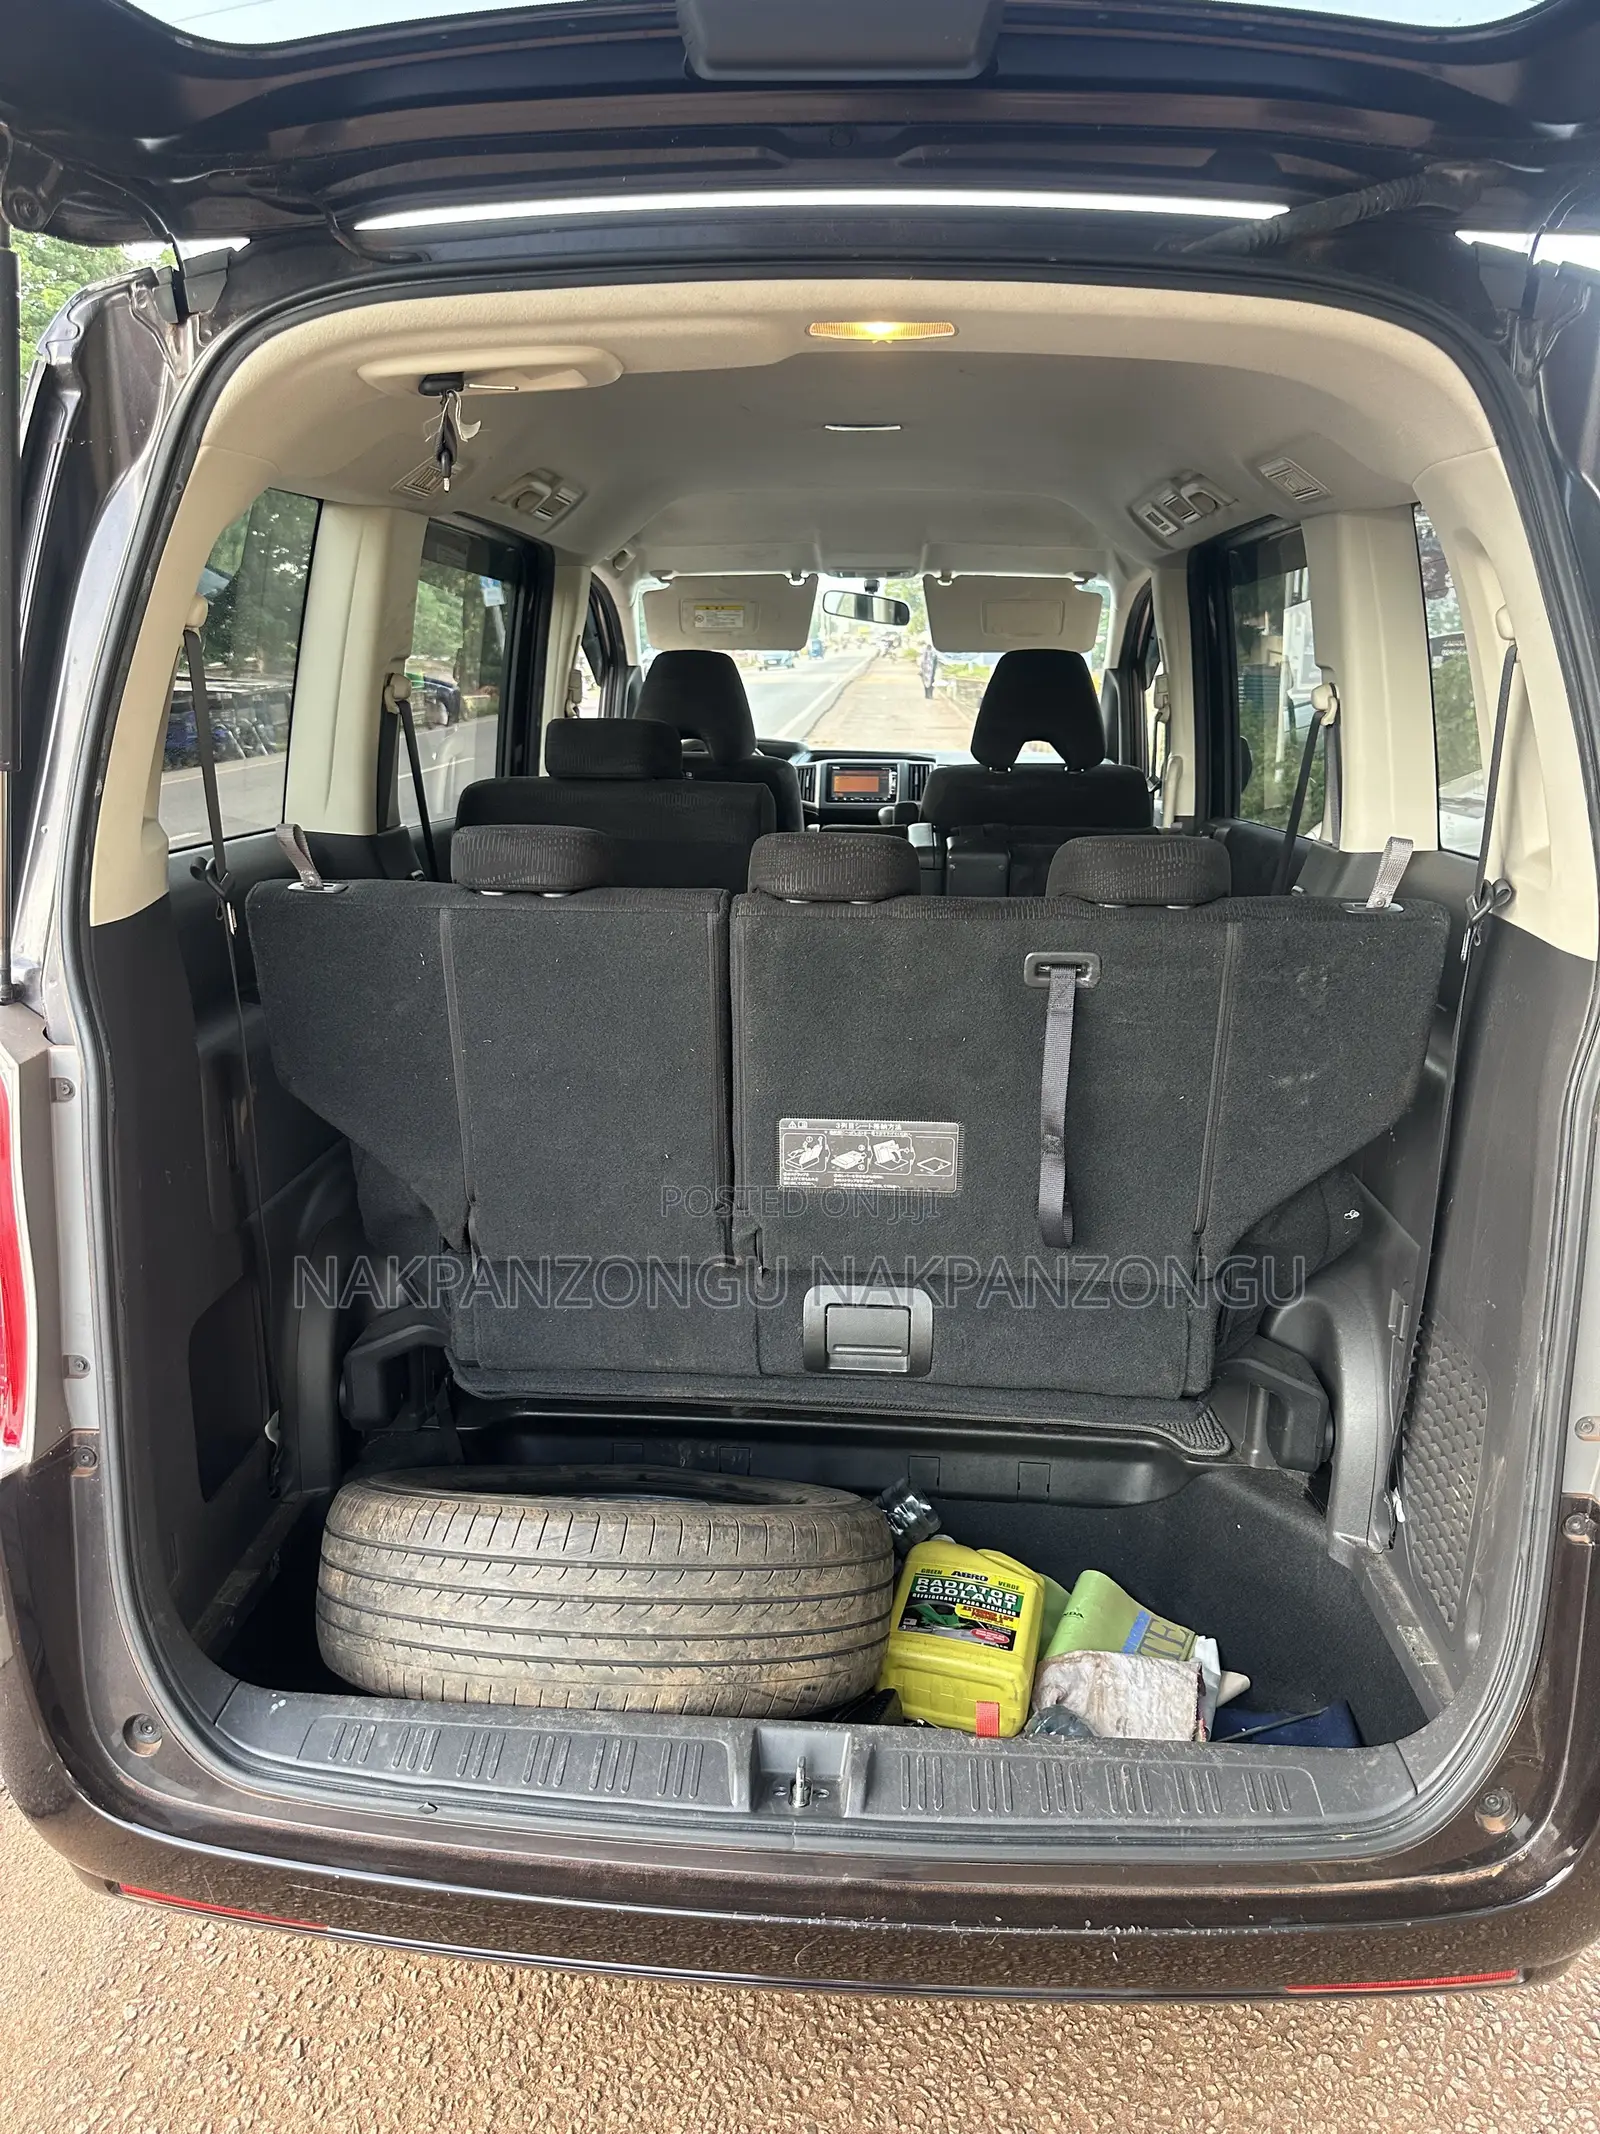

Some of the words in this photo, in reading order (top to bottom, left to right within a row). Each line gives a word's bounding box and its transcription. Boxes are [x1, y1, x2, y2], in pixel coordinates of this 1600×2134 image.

[951, 1570, 989, 1582] ABRO
[997, 1580, 1020, 1590] VERDE
[915, 1585, 1016, 1609] COOLANT
[917, 1577, 1018, 1602] RADIATOR
[912, 1593, 961, 1603] REFRIGERANTE
[962, 1599, 980, 1608] PARA
[981, 1603, 1017, 1616] RADIADOR
